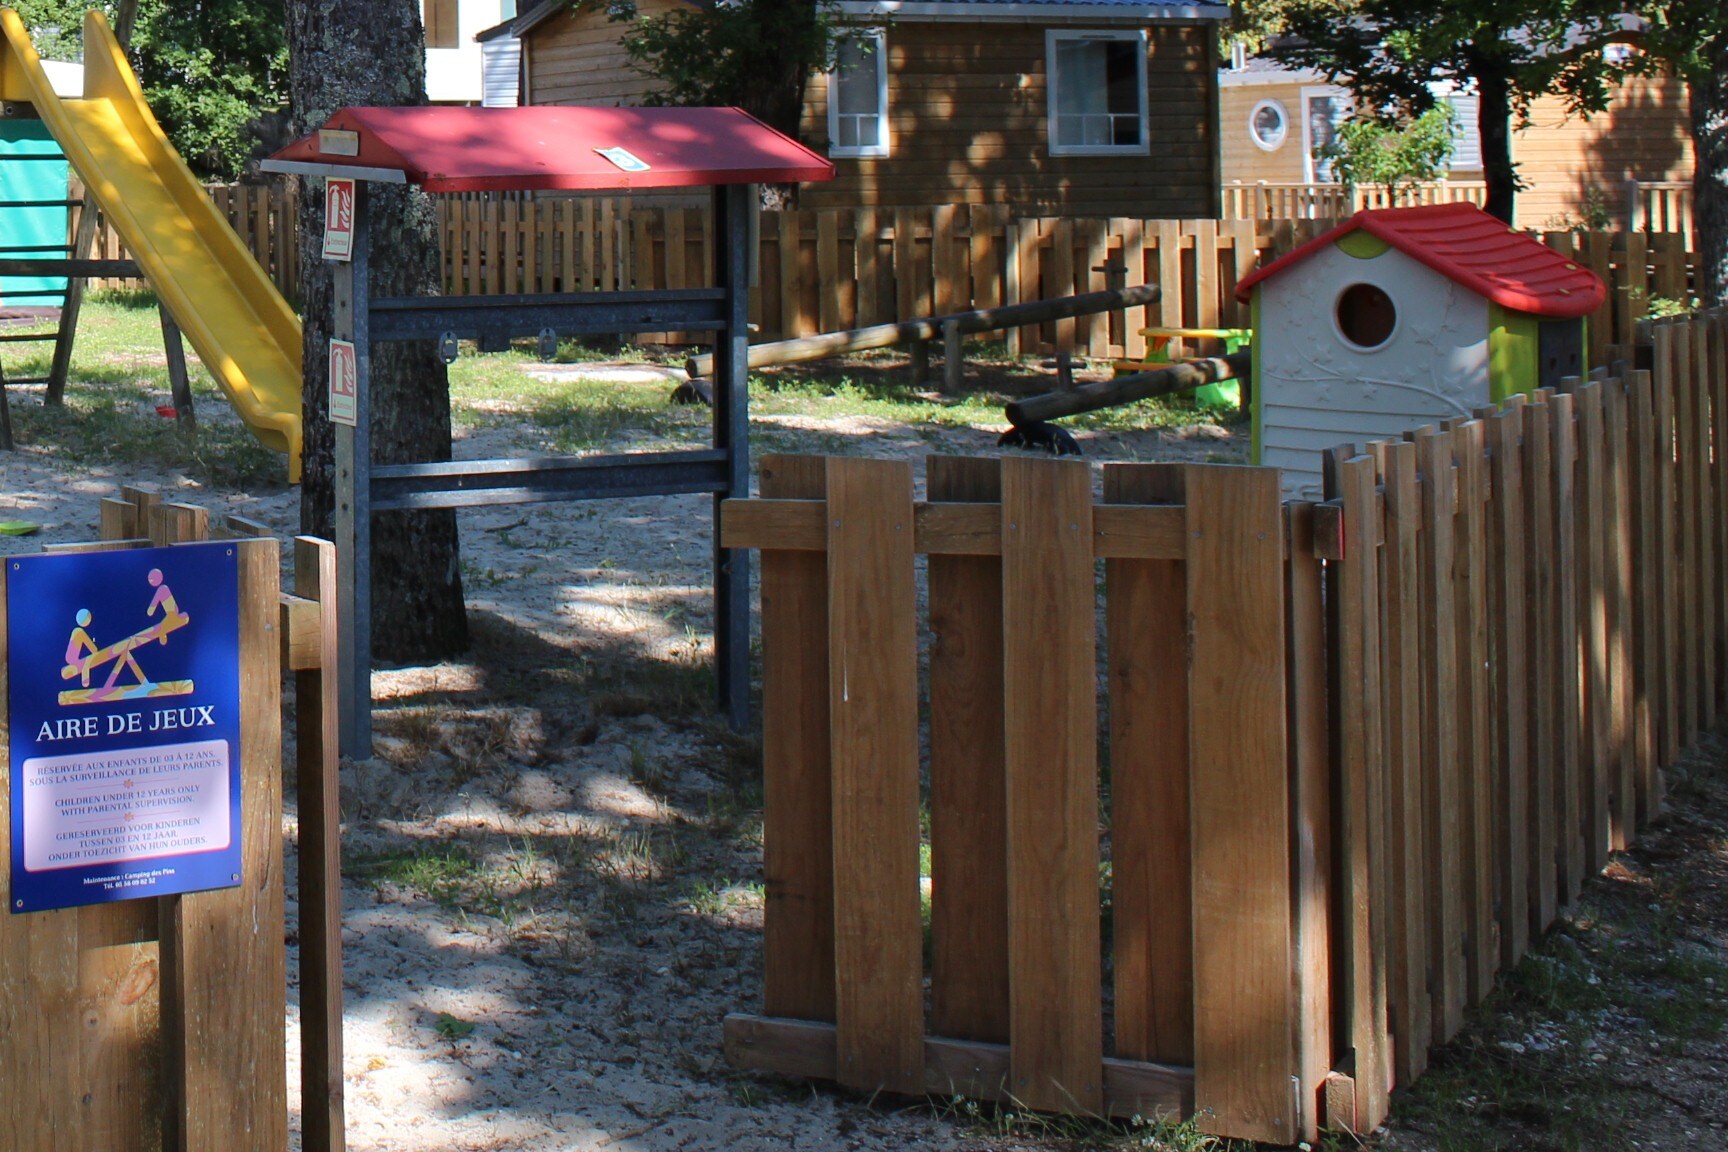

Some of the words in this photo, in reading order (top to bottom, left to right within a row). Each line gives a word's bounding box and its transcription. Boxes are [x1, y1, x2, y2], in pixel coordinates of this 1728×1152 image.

[36, 717, 98, 742] AIRE
[107, 714, 141, 735] DE
[149, 706, 215, 732] JEUX
[37, 762, 82, 775] RÉSERVÉE
[87, 761, 104, 770] AUX
[108, 758, 146, 769] ENFANTS
[150, 756, 161, 764] DE
[185, 752, 194, 760] 12
[30, 775, 53, 786] SOUS
[56, 774, 68, 783] LA
[70, 767, 135, 781] SURVEILLANCE
[139, 766, 150, 774] DE
[153, 764, 180, 773] LEURS
[55, 795, 100, 808] CHILDREN
[103, 792, 134, 802] UNDER
[148, 788, 175, 797] YEARS
[178, 784, 200, 794] ONLY
[61, 806, 85, 816] WITH
[87, 802, 133, 814] PARENTAL
[56, 827, 126, 840] GERESERVEERD
[129, 822, 153, 832] VOOR
[156, 818, 200, 829] KINDEREN
[48, 852, 81, 862] ONDER
[83, 846, 127, 858] TOEZICHT
[129, 843, 147, 852] VAN
[149, 841, 168, 850] HUN
[79, 838, 113, 848] TUSSEN
[128, 835, 139, 843] EN
[141, 833, 150, 841] 12
[151, 869, 162, 877] des
